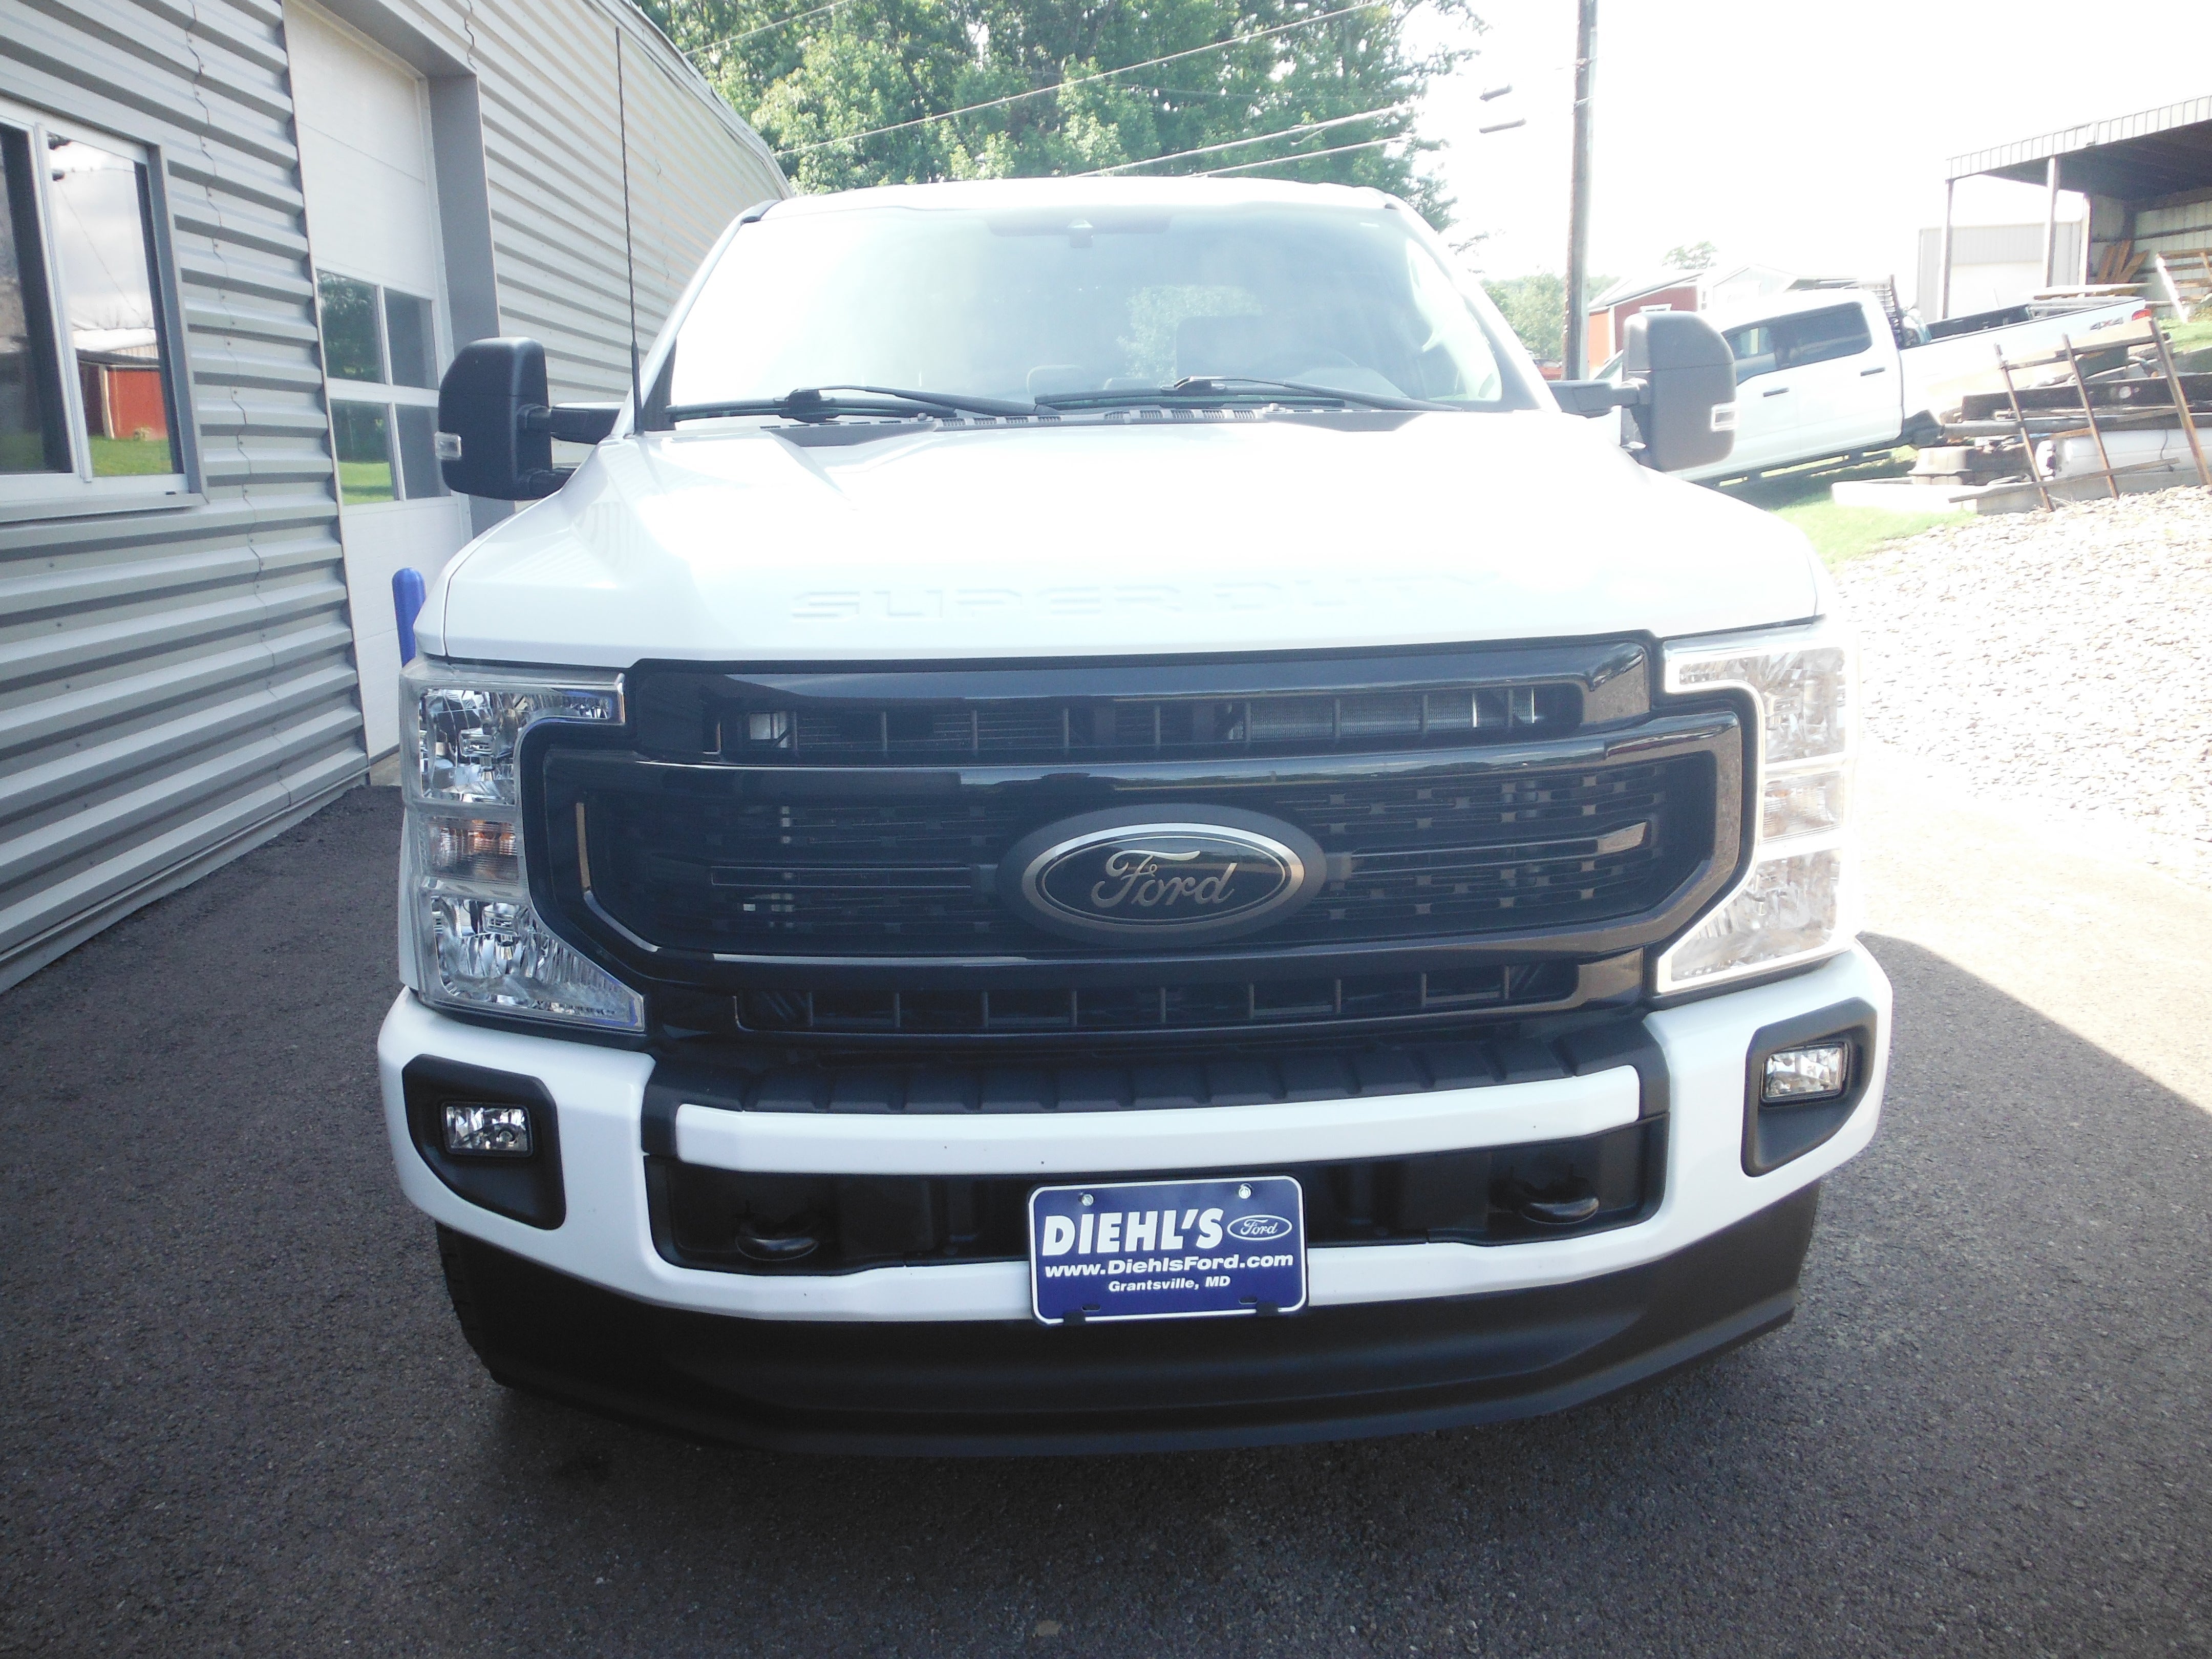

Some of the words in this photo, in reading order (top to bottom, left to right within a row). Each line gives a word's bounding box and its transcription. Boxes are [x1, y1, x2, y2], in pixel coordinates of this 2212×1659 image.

[789, 584, 1184, 621] SUPER
[1091, 849, 1237, 908] Ford
[1041, 1207, 1224, 1257] DIEHL'S
[1240, 1219, 1278, 1235] Ford
[1045, 1254, 1294, 1278] www.DiehlsFord.com
[1108, 1278, 1200, 1292] Grantsville,
[1205, 1275, 1231, 1287] MD
